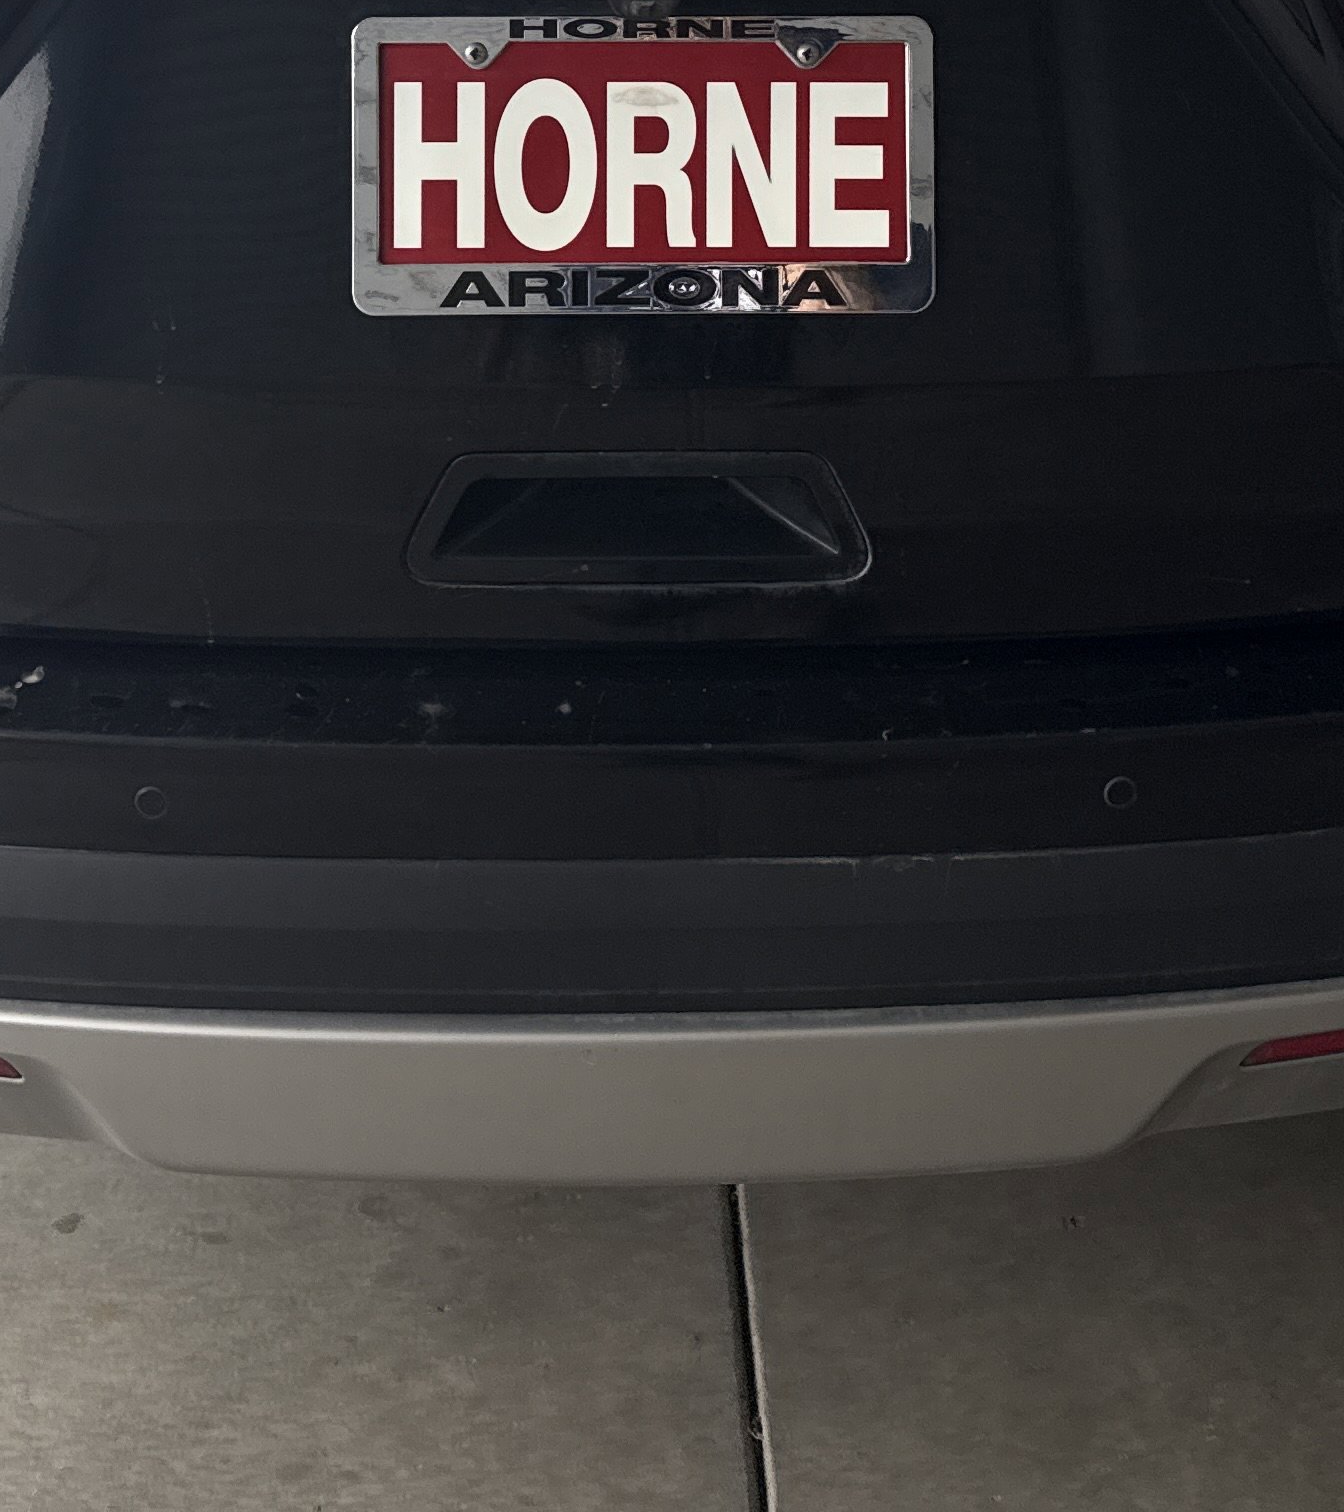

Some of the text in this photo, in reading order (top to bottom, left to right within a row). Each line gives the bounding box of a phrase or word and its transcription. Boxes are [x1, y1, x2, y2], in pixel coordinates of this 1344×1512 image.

[509, 18, 778, 40] HORNE
[393, 78, 890, 252] HORNE
[439, 269, 848, 309] ARIZONA
